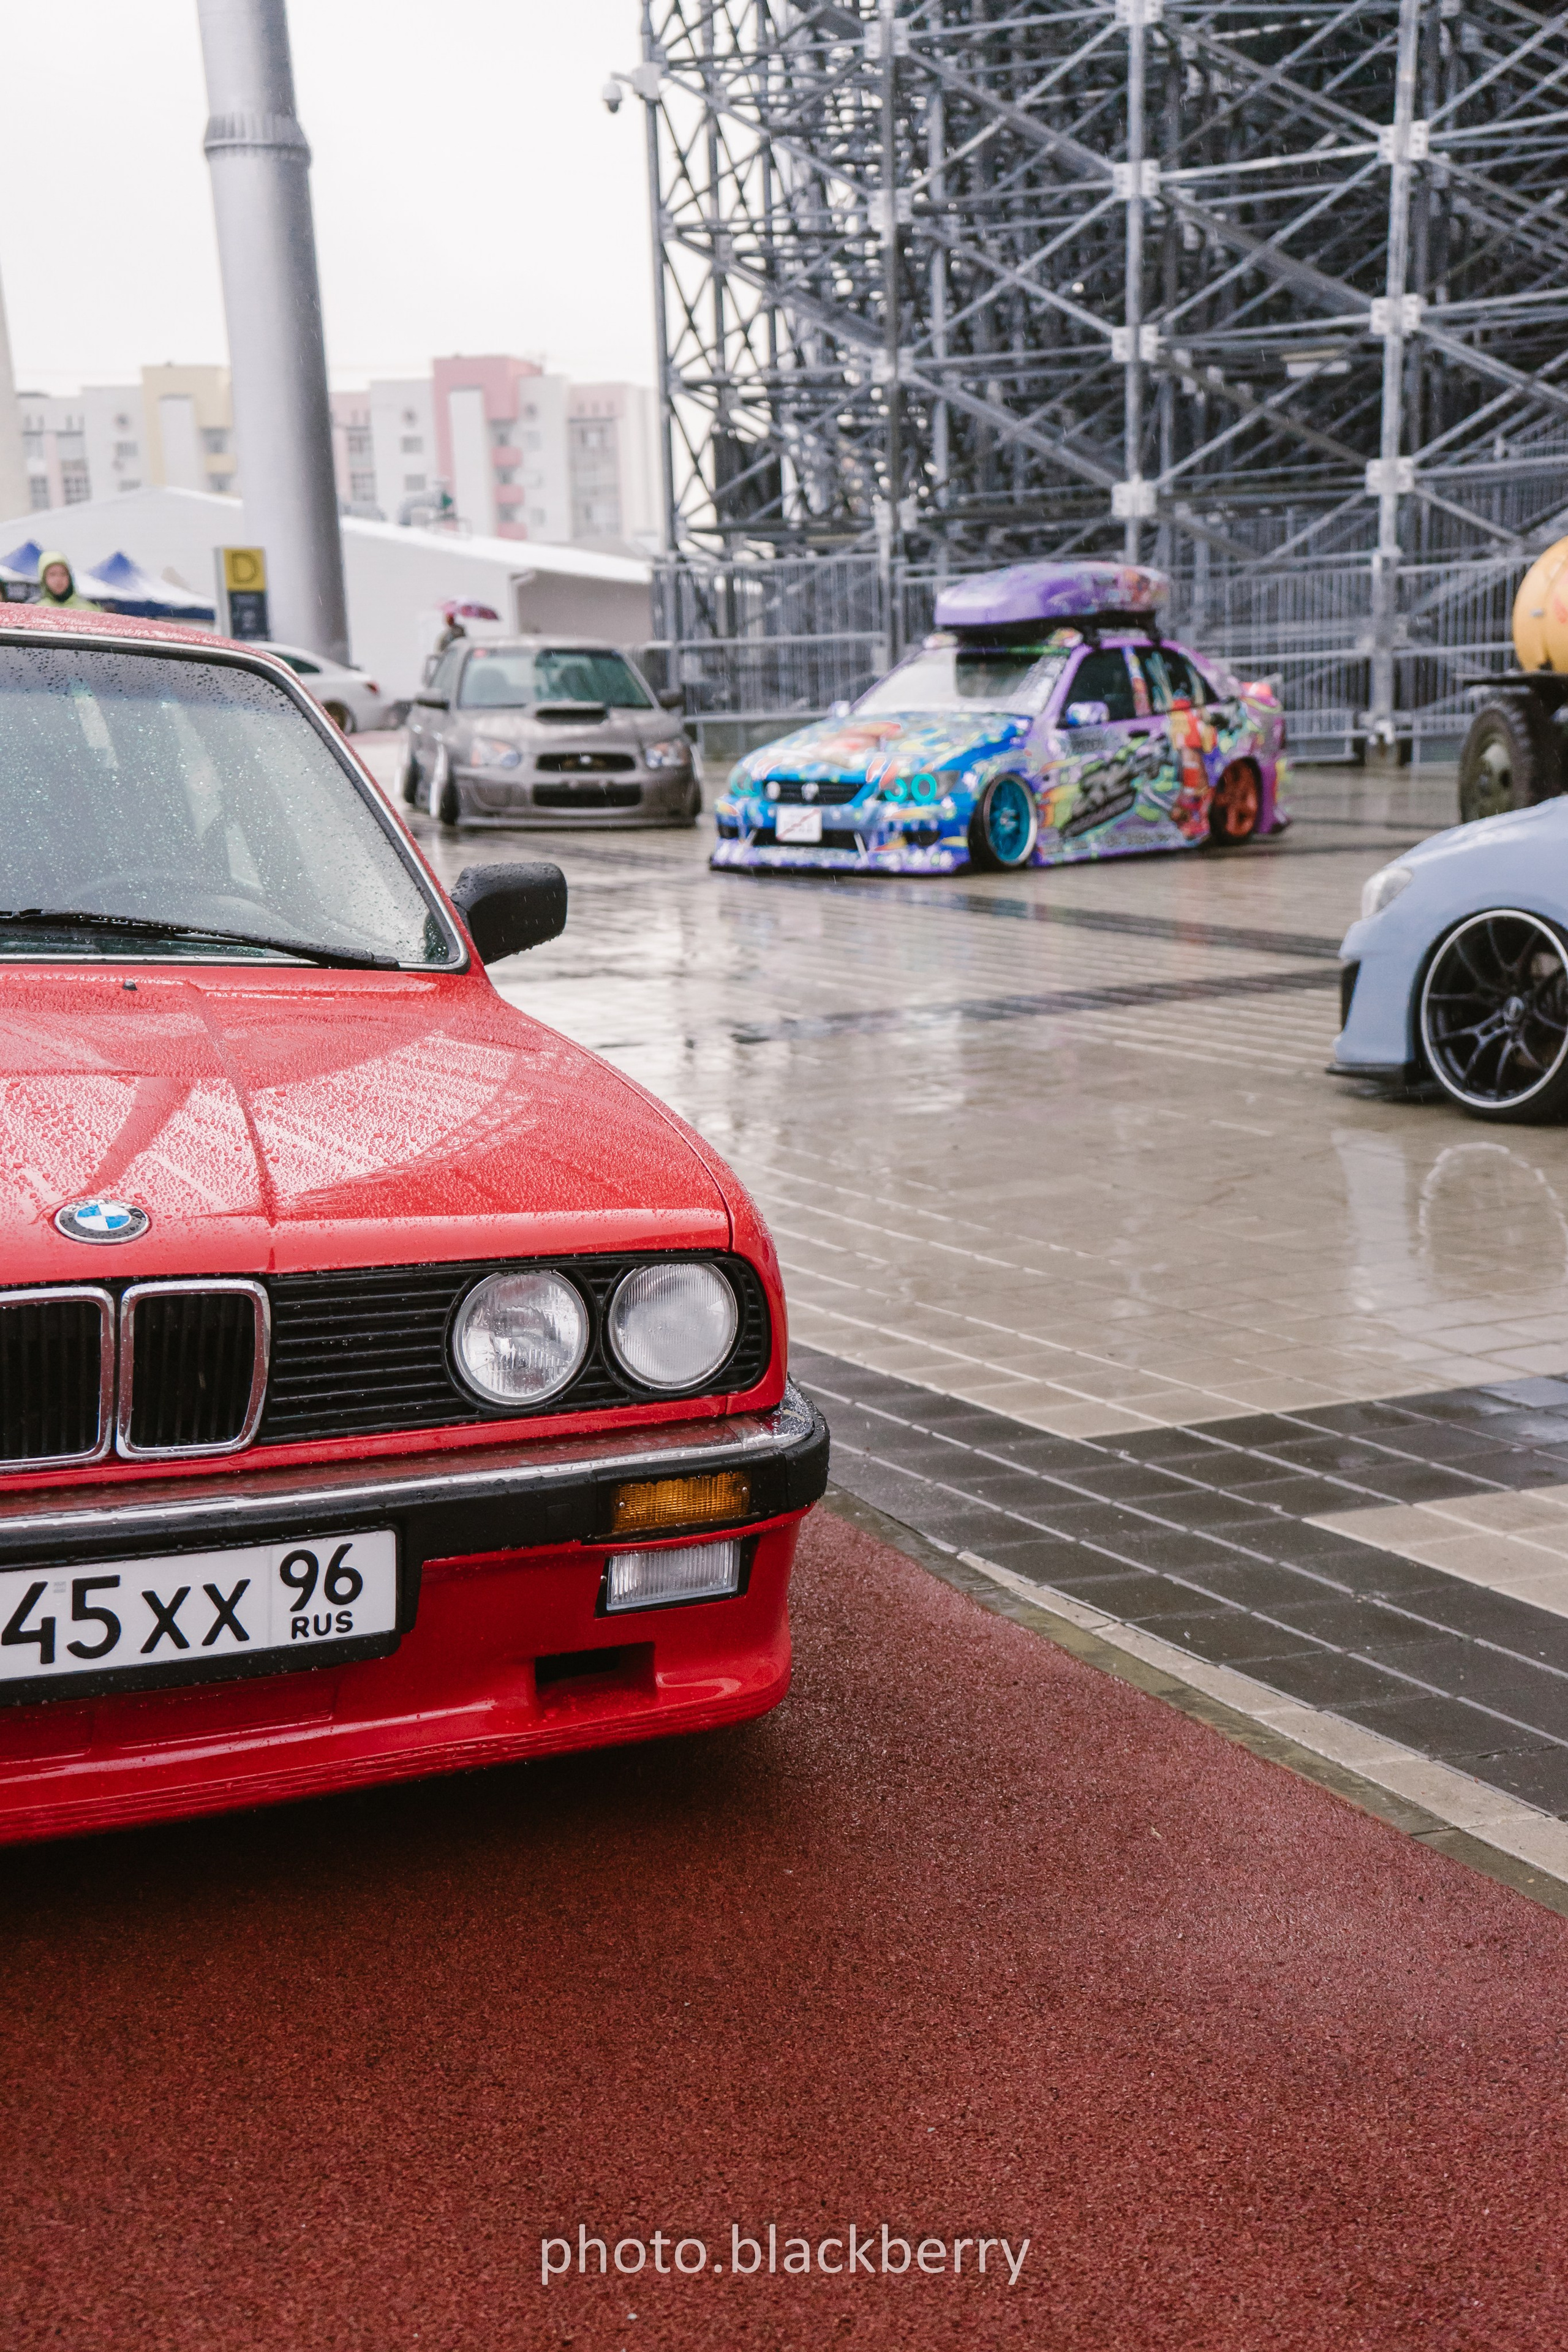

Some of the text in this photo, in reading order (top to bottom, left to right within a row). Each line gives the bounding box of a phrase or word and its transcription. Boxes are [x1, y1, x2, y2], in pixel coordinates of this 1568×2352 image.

[231, 552, 259, 584] D
[280, 1543, 363, 1611] 96
[291, 1610, 353, 1640] RUS
